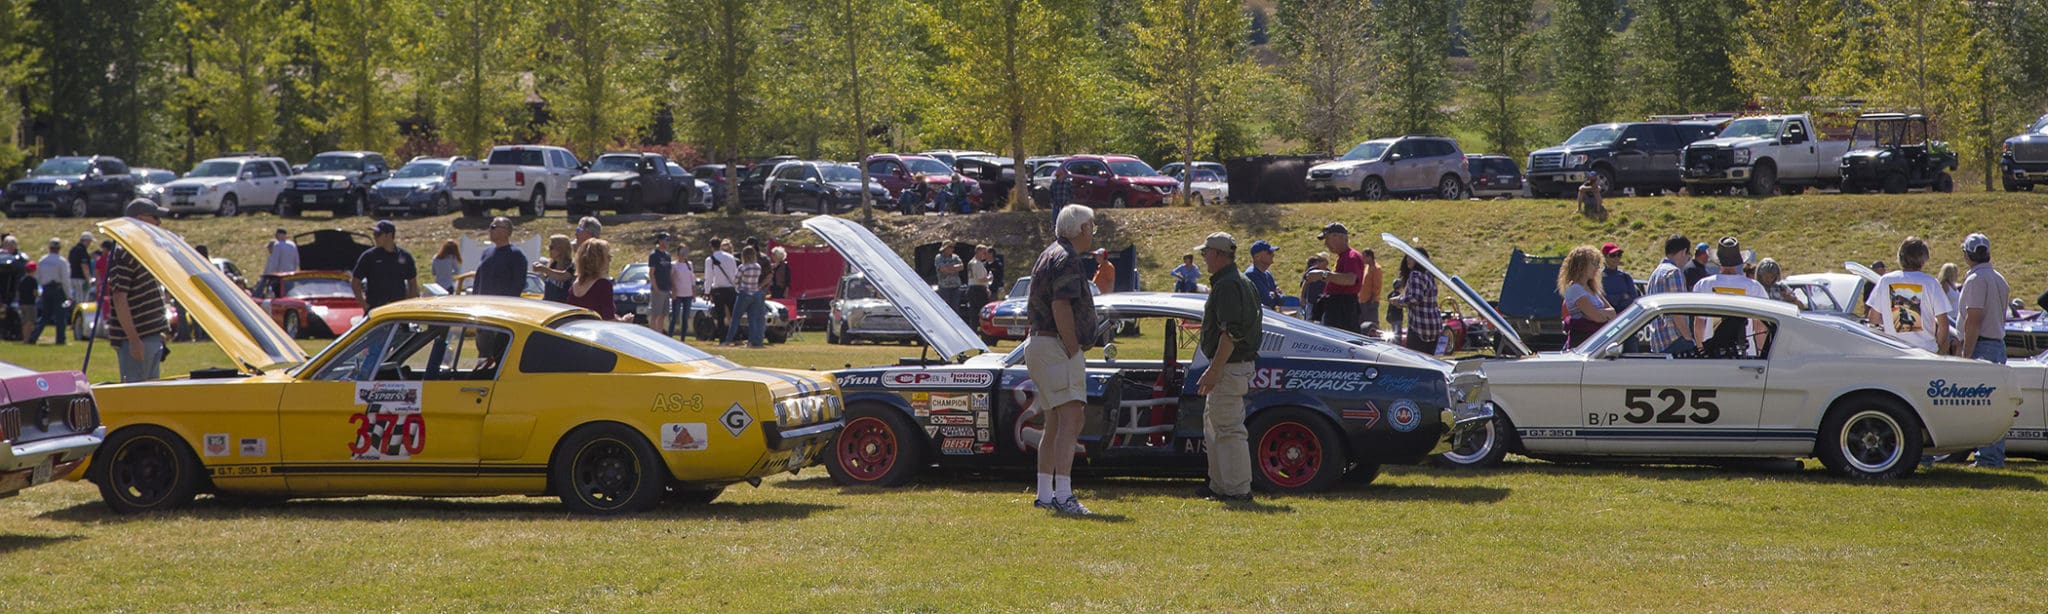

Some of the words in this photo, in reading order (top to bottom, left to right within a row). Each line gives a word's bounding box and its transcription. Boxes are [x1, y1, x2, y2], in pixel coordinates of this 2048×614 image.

[953, 377, 988, 385] moody
[1285, 369, 1364, 381] PERFORMANCE
[1285, 378, 1373, 392] EXHAUST
[1927, 379, 1996, 398] Schaefer
[651, 393, 704, 413] AS-3
[932, 399, 967, 407] CHAMPION
[1624, 388, 1720, 425] 525
[1933, 398, 1992, 406] MOTORSPORTS
[726, 411, 744, 429] G
[1589, 412, 1619, 426] B/P
[348, 412, 426, 455] 370
[944, 440, 970, 448] DEIST
[238, 466, 257, 475] 350
